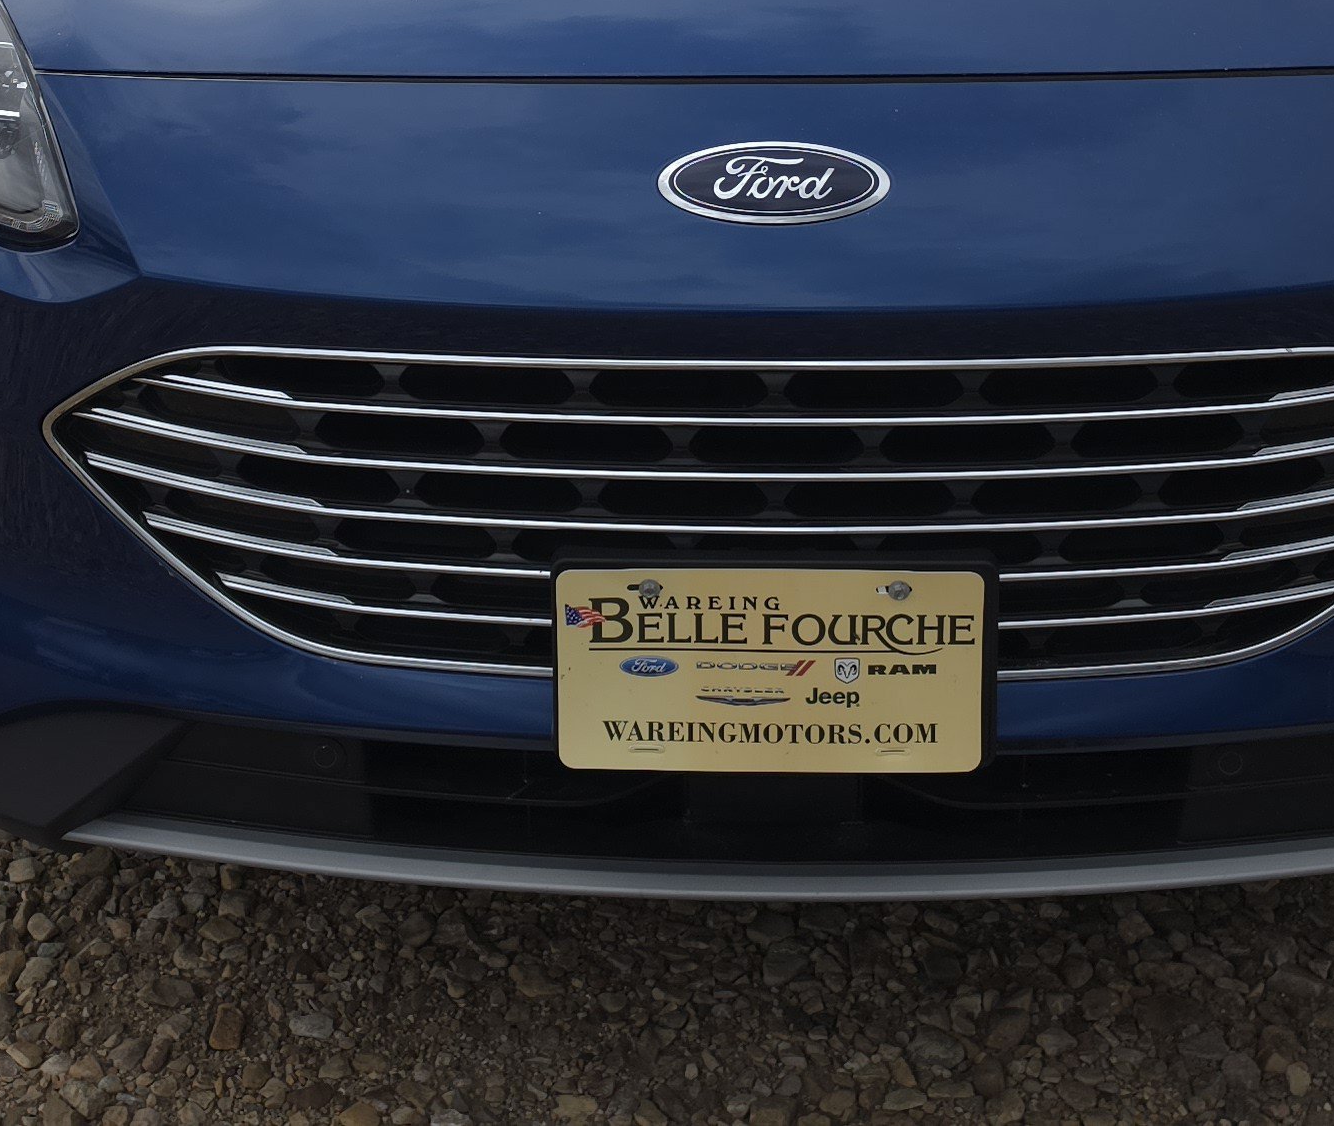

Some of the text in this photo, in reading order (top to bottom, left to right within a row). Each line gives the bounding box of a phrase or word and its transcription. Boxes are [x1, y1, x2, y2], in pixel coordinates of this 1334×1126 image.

[713, 155, 835, 200] Ford
[638, 596, 780, 611] WAREING
[588, 597, 976, 655] BELLE FOURCHE
[631, 658, 937, 675] Ford DODGE RAM
[805, 687, 861, 709] Jeep
[602, 720, 939, 745] WAREINGMOTORS.COM
